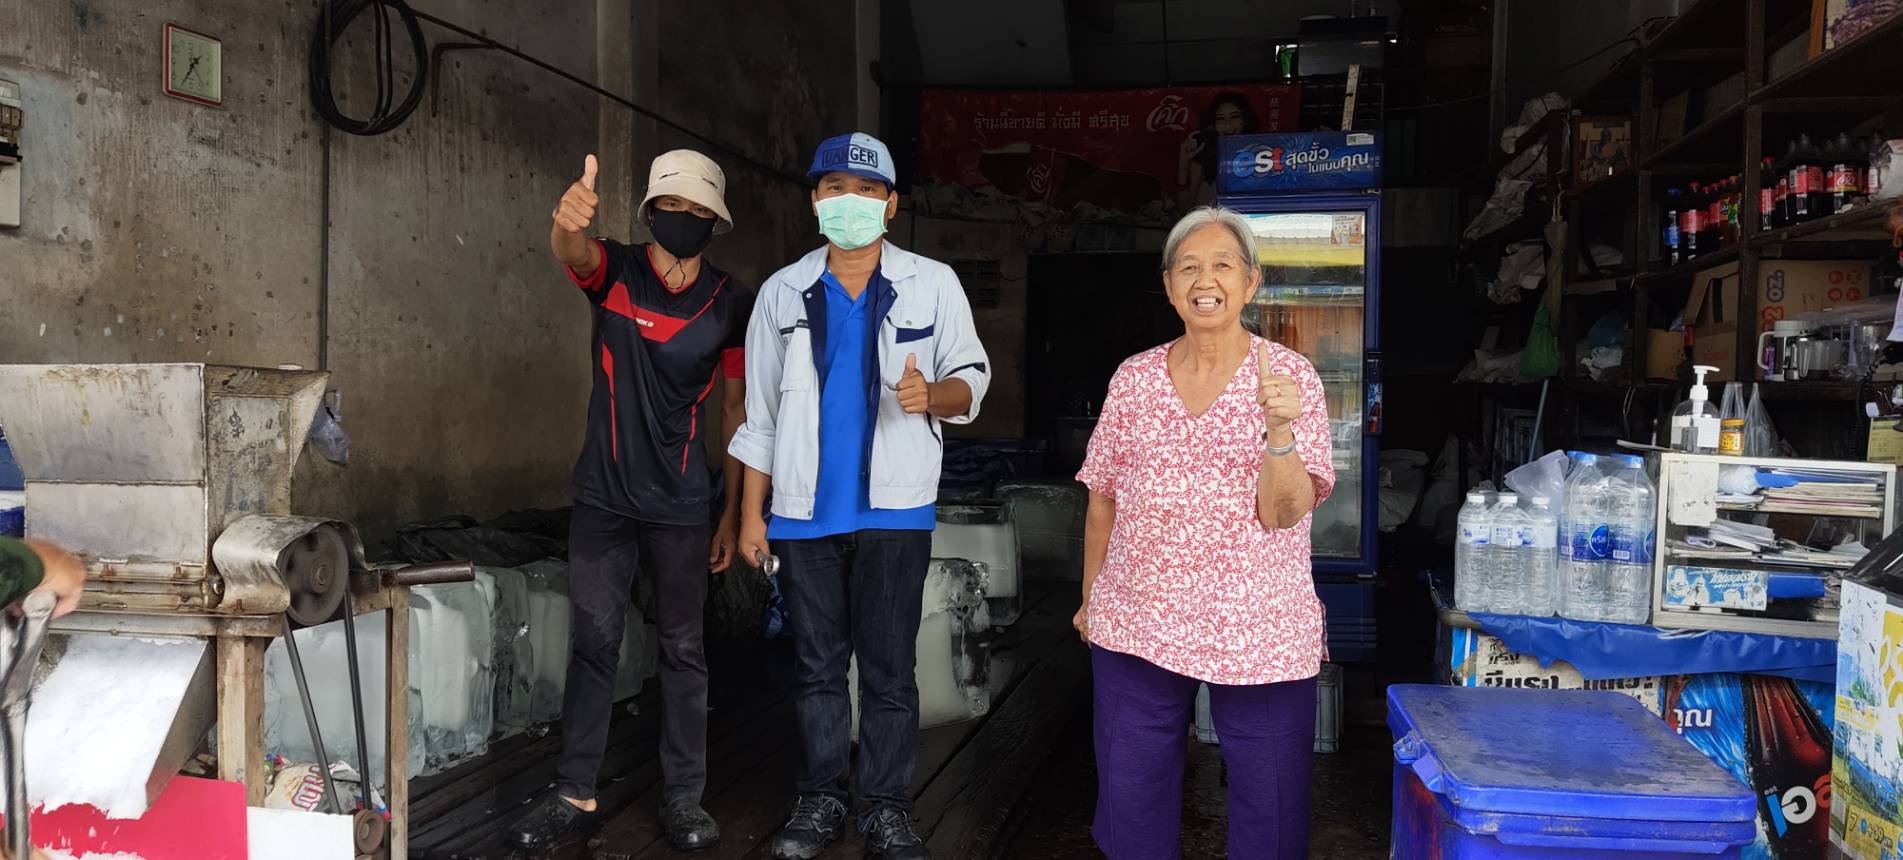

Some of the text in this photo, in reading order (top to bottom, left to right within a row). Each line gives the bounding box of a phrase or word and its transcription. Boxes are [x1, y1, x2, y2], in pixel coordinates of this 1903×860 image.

[825, 147, 876, 165] DANGER
[1233, 147, 1284, 177] est
[1286, 142, 1329, 170] สุดขั้ว
[1309, 152, 1369, 174] ในแบบคุณ
